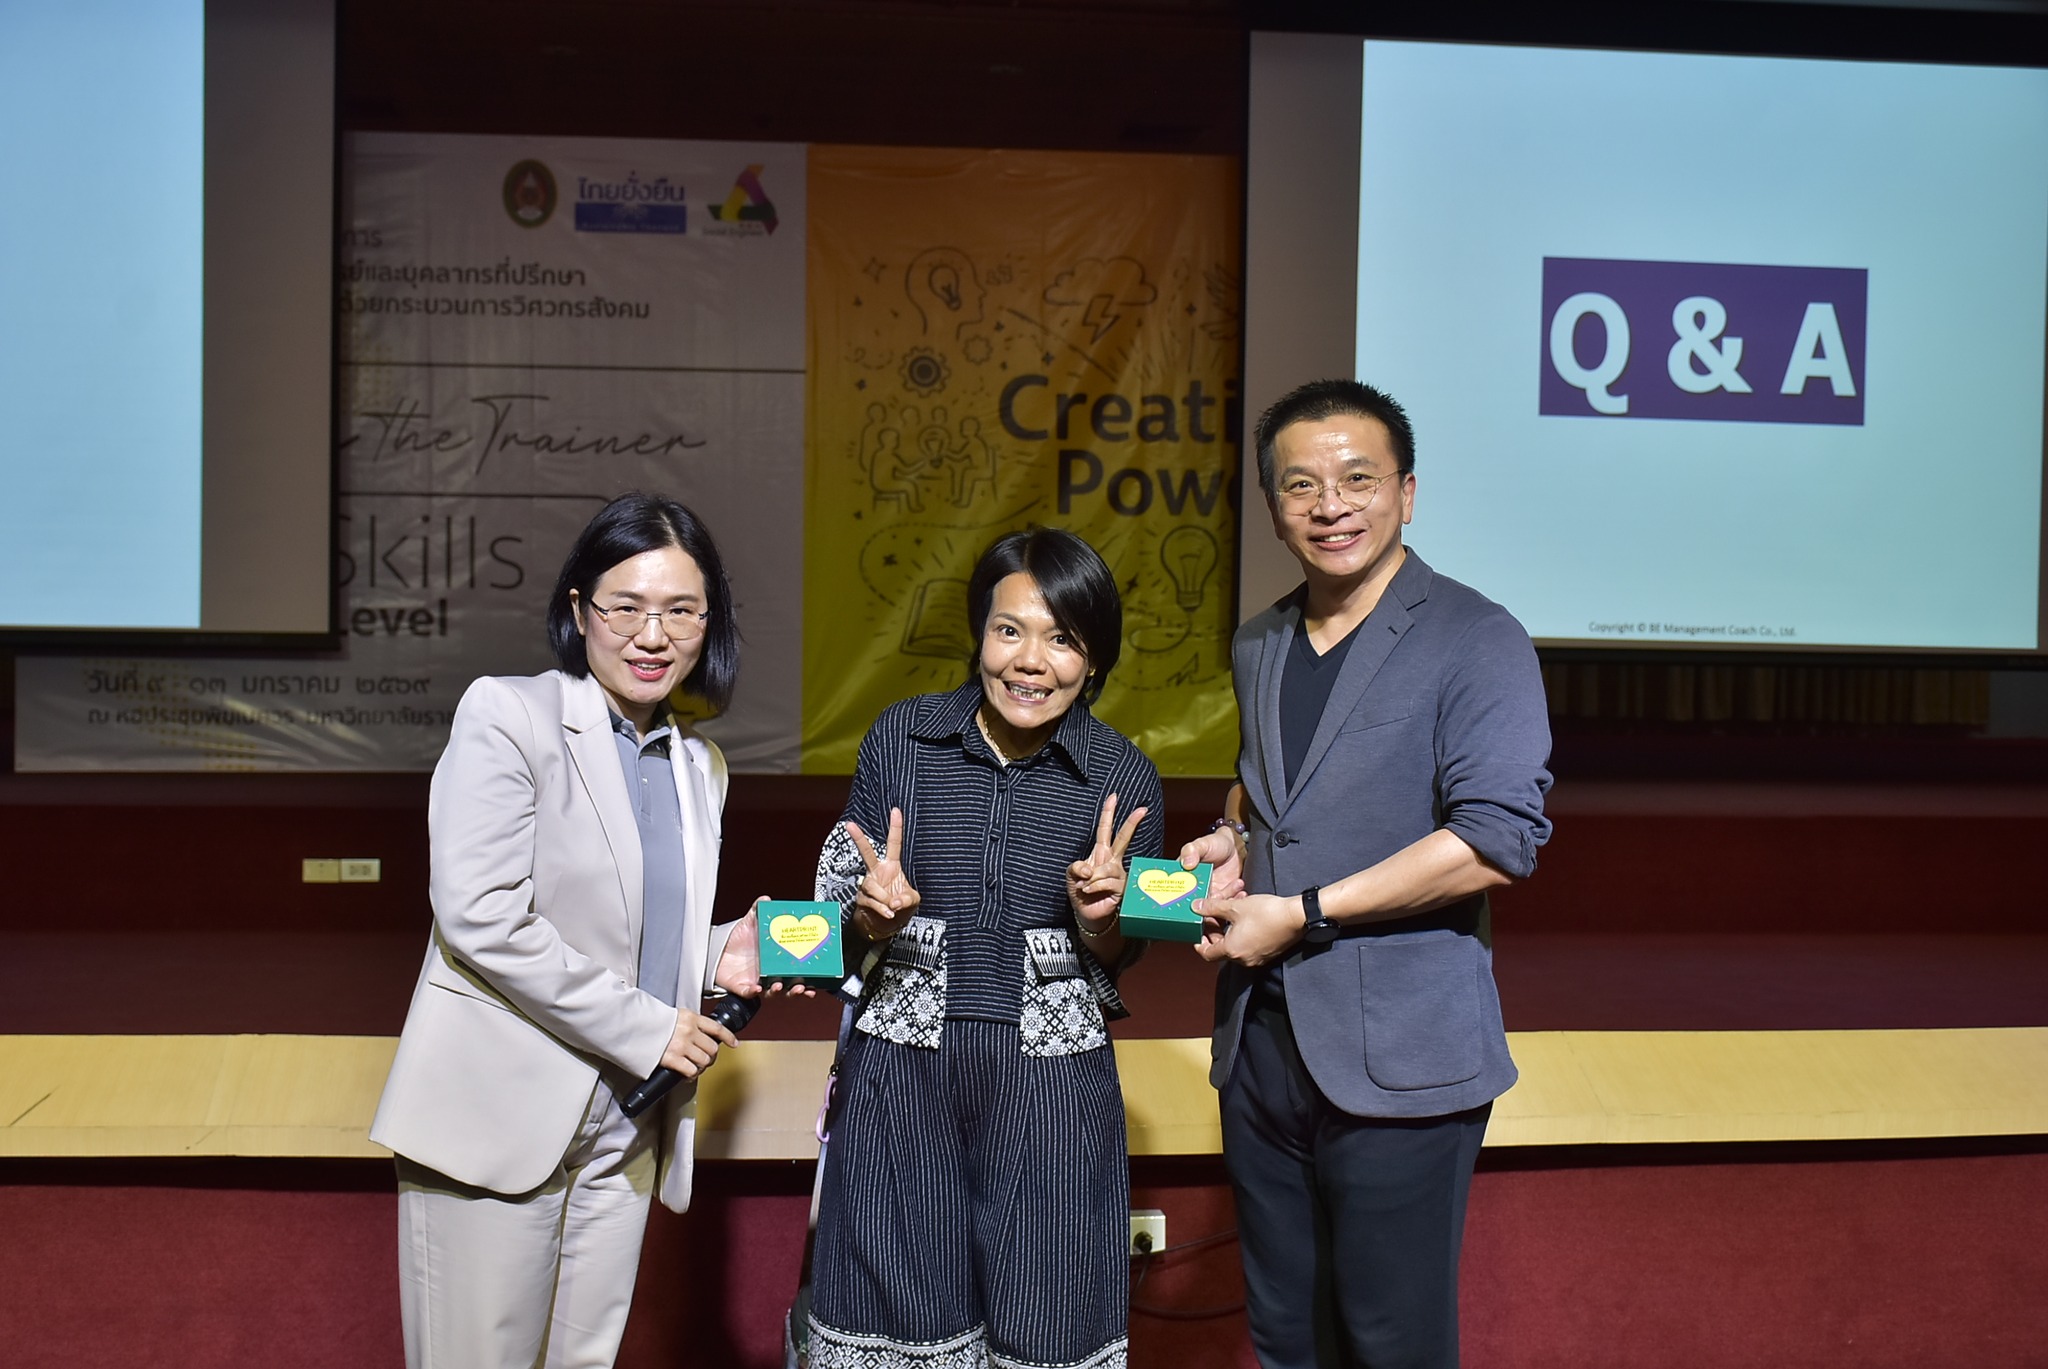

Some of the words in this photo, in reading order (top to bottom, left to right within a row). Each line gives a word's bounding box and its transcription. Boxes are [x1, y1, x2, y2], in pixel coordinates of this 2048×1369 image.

[578, 169, 685, 202] ไทยยั่งยืน
[1550, 292, 1630, 415] Q
[1668, 296, 1753, 394] &
[1780, 302, 1857, 397] A
[472, 393, 707, 476] Trainer
[999, 374, 1239, 443] Creati
[1057, 449, 1239, 517] Pow
[338, 598, 447, 638] evel
[1588, 621, 1634, 634] Copyright
[1664, 623, 1726, 636] Management
[1729, 625, 1757, 636] Coach
[88, 667, 138, 694] วันที่
[242, 675, 341, 695] มกราคม
